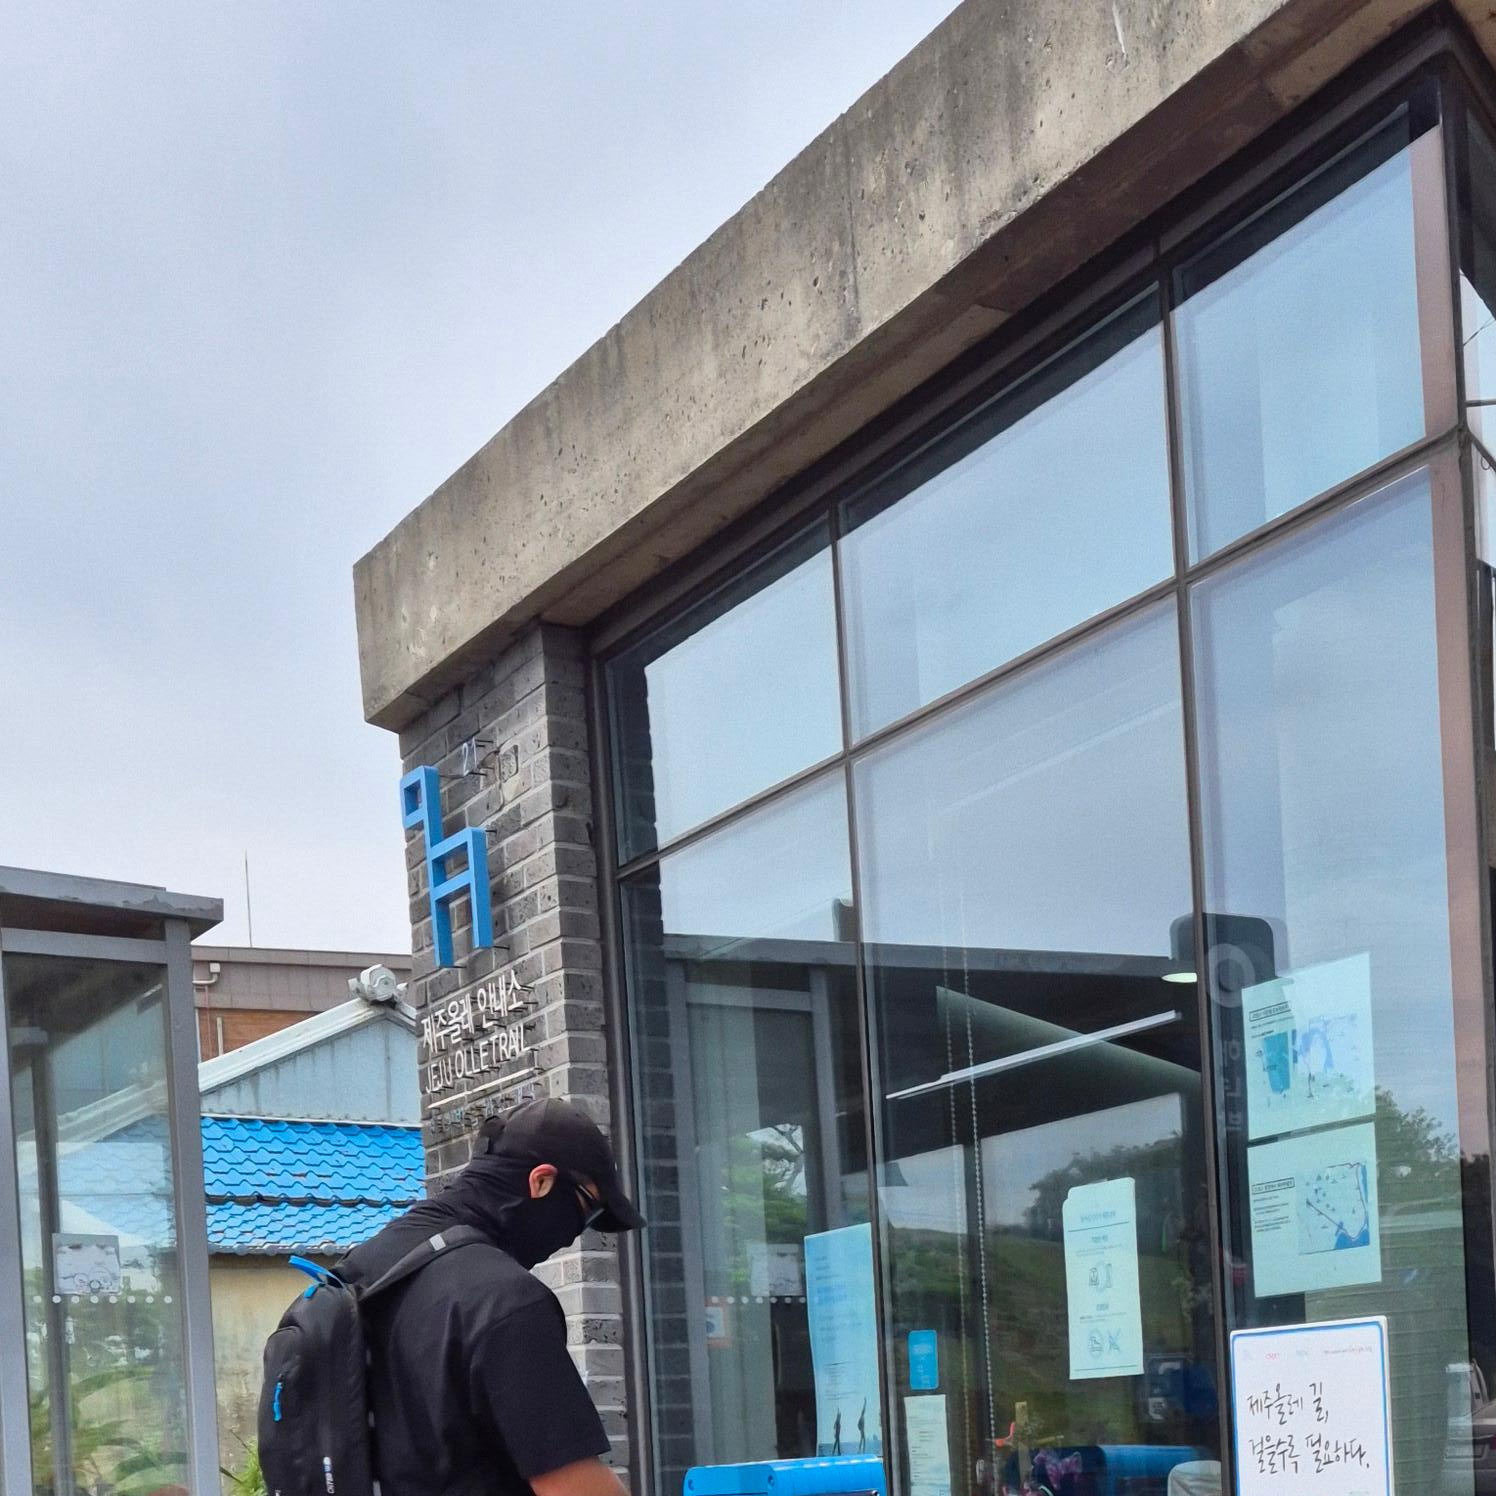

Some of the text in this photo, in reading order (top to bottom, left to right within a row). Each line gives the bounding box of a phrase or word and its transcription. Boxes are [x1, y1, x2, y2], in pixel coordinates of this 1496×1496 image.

[421, 970, 524, 1055] 제주올레 안내소
[425, 1023, 532, 1094] JEJU OLLE TRAIL
[1247, 1381, 1329, 1425] 제주올레 길,
[1249, 1434, 1302, 1474] 걸을수록
